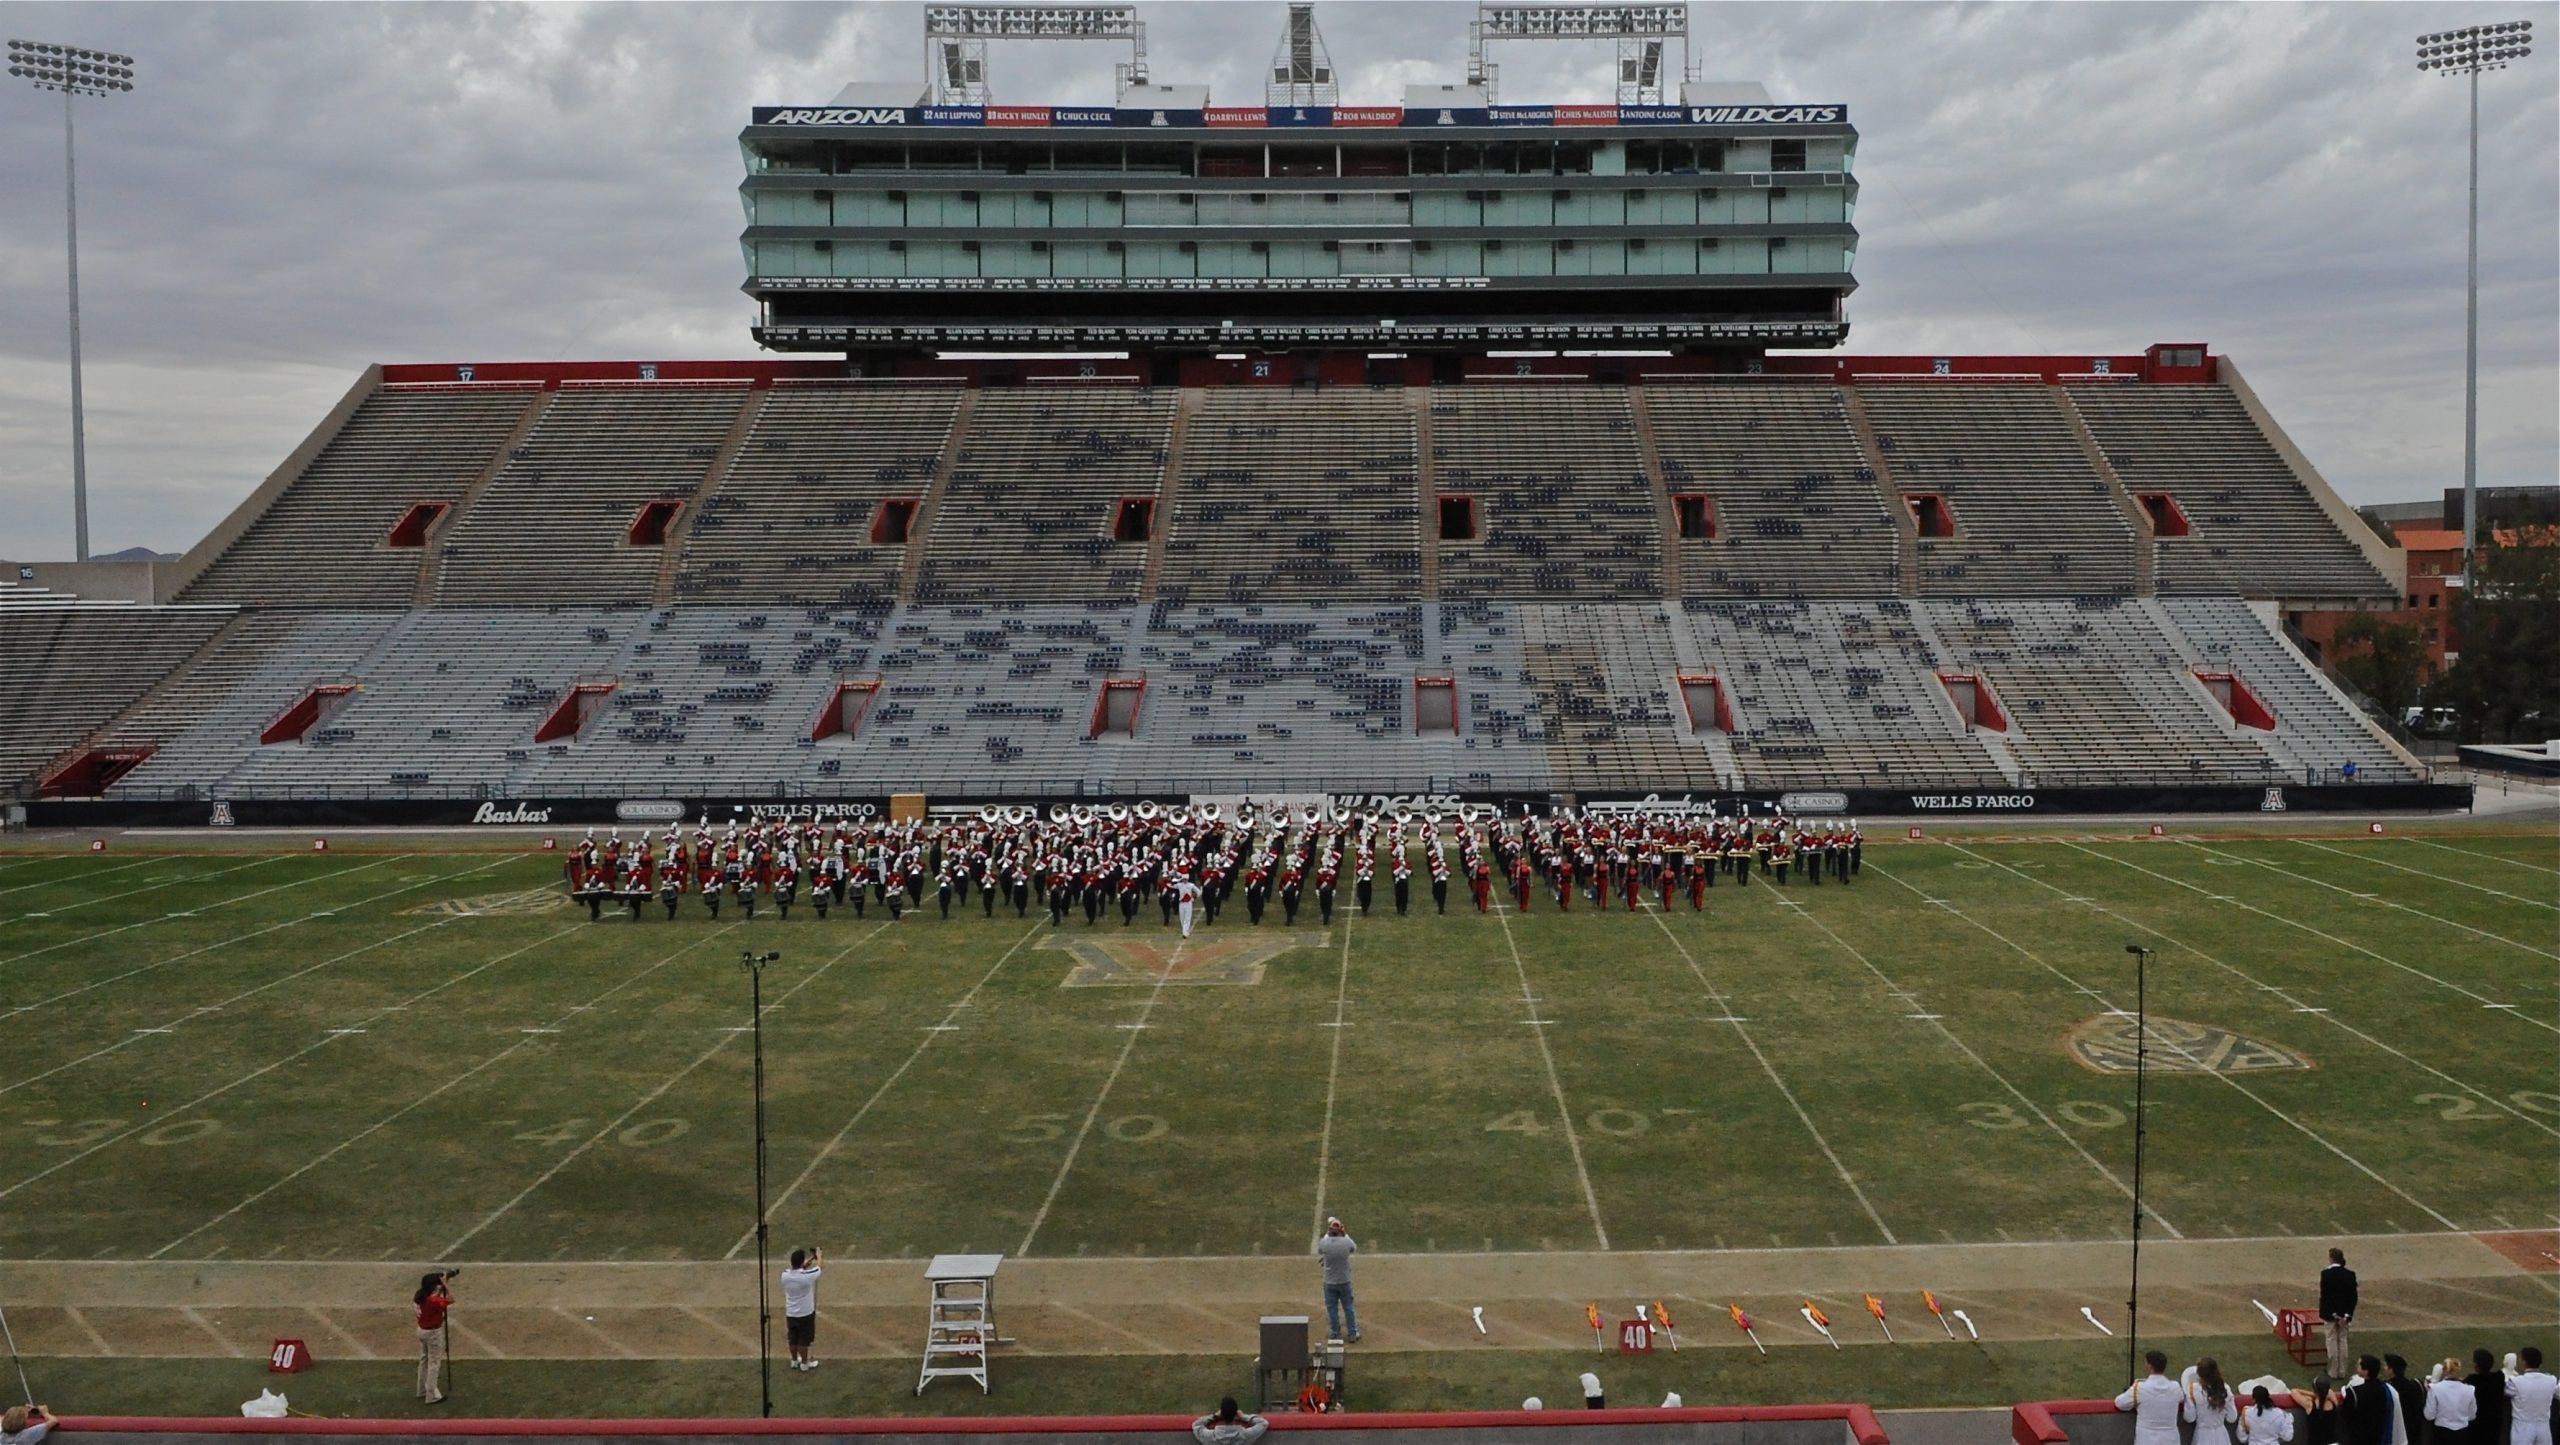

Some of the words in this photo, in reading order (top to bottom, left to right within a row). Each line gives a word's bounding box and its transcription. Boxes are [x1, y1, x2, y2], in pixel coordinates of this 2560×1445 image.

[768, 109, 905, 124] ARIZONA
[924, 110, 933, 120] 22
[934, 111, 948, 119] ART
[949, 111, 982, 120] LUPPINO
[997, 111, 1019, 120] RICKY
[1021, 111, 1050, 120] HUNLEY
[1063, 112, 1089, 121] CHUCK
[1090, 112, 1112, 121] CECIL
[1204, 112, 1209, 121] 4
[1244, 112, 1266, 121] LEWIS
[1360, 112, 1396, 120] WALDROP
[1562, 111, 1581, 119] CHRIS
[1626, 110, 1655, 119] ANTOINE
[1657, 110, 1681, 119] CASON
[1692, 107, 1839, 123] WILDCATS
[1080, 367, 1096, 377] 20
[1255, 365, 1269, 376] 21
[1516, 364, 1531, 375] 22
[1747, 363, 1762, 374] 23
[1934, 364, 1949, 375] 24
[2094, 364, 2109, 375] 25
[460, 371, 473, 382] 17
[641, 369, 655, 380] 18
[20, 567, 33, 578] 16
[1911, 796, 1973, 809] WELLS
[1976, 795, 2034, 808] FARGO
[472, 801, 552, 823] Bashas'
[750, 804, 812, 817] WELLS
[817, 803, 876, 817] FARGO
[1625, 1325, 1646, 1349] 40
[273, 1344, 295, 1368] 40
